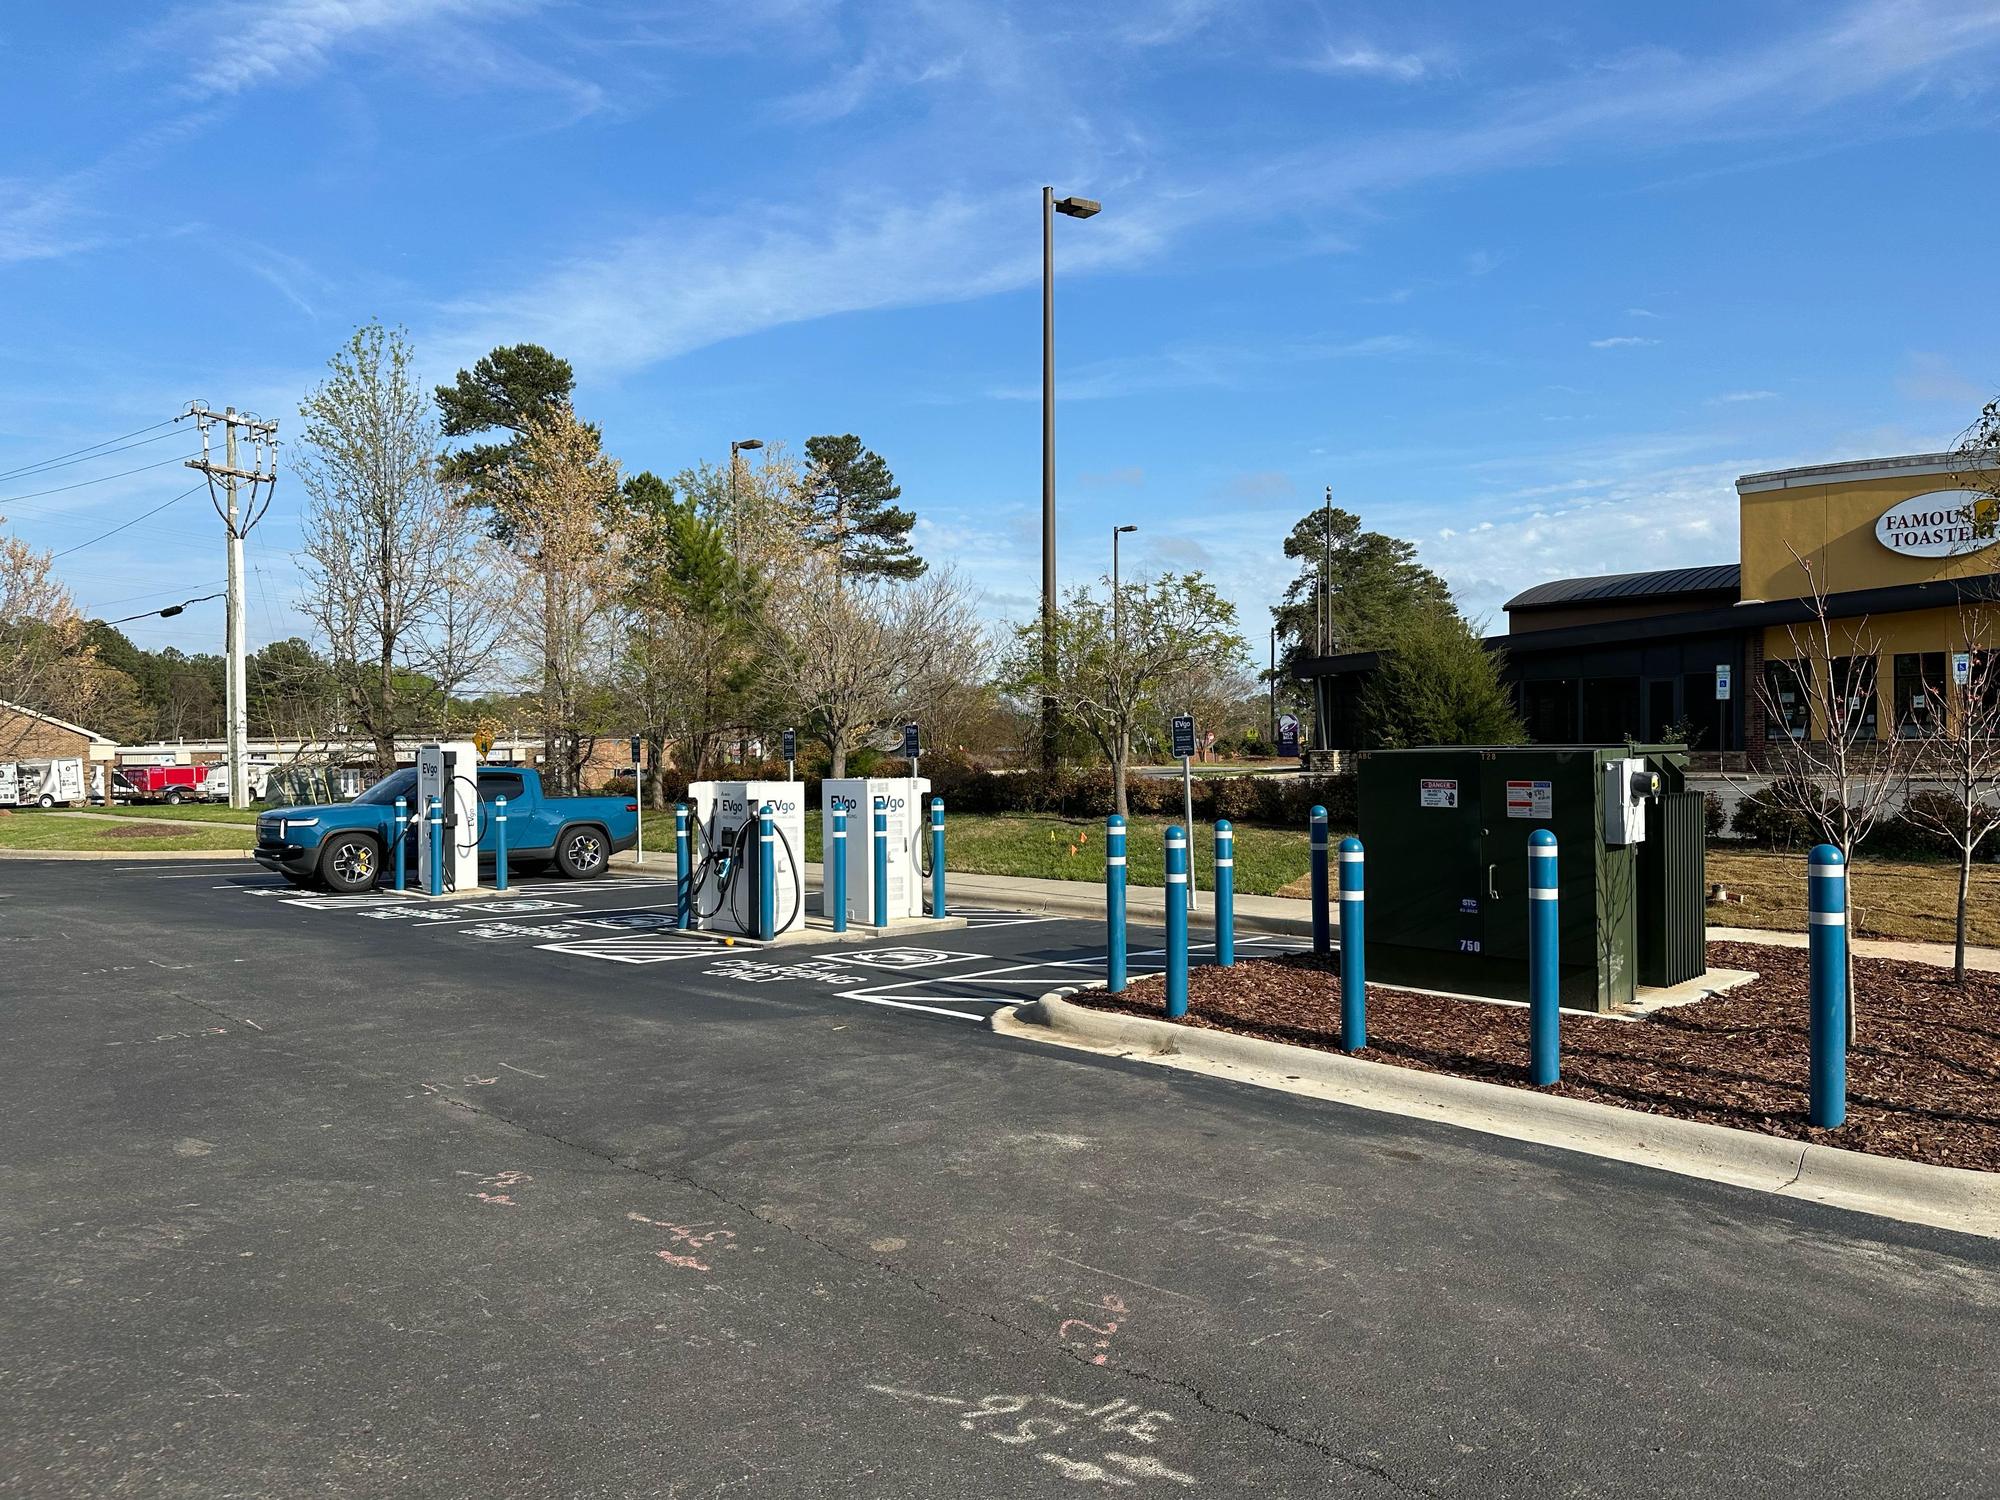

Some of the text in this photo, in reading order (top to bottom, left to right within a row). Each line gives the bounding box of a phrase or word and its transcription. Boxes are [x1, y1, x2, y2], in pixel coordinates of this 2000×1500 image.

[1175, 721, 1191, 729] EVgo
[422, 763, 438, 777] EVgo
[722, 800, 743, 815] EVgo
[1462, 899, 1477, 907] STC
[1460, 940, 1480, 952] 750
[710, 958, 867, 984] CHARGING
[793, 961, 852, 971] EV
[701, 968, 798, 982] ONLY
